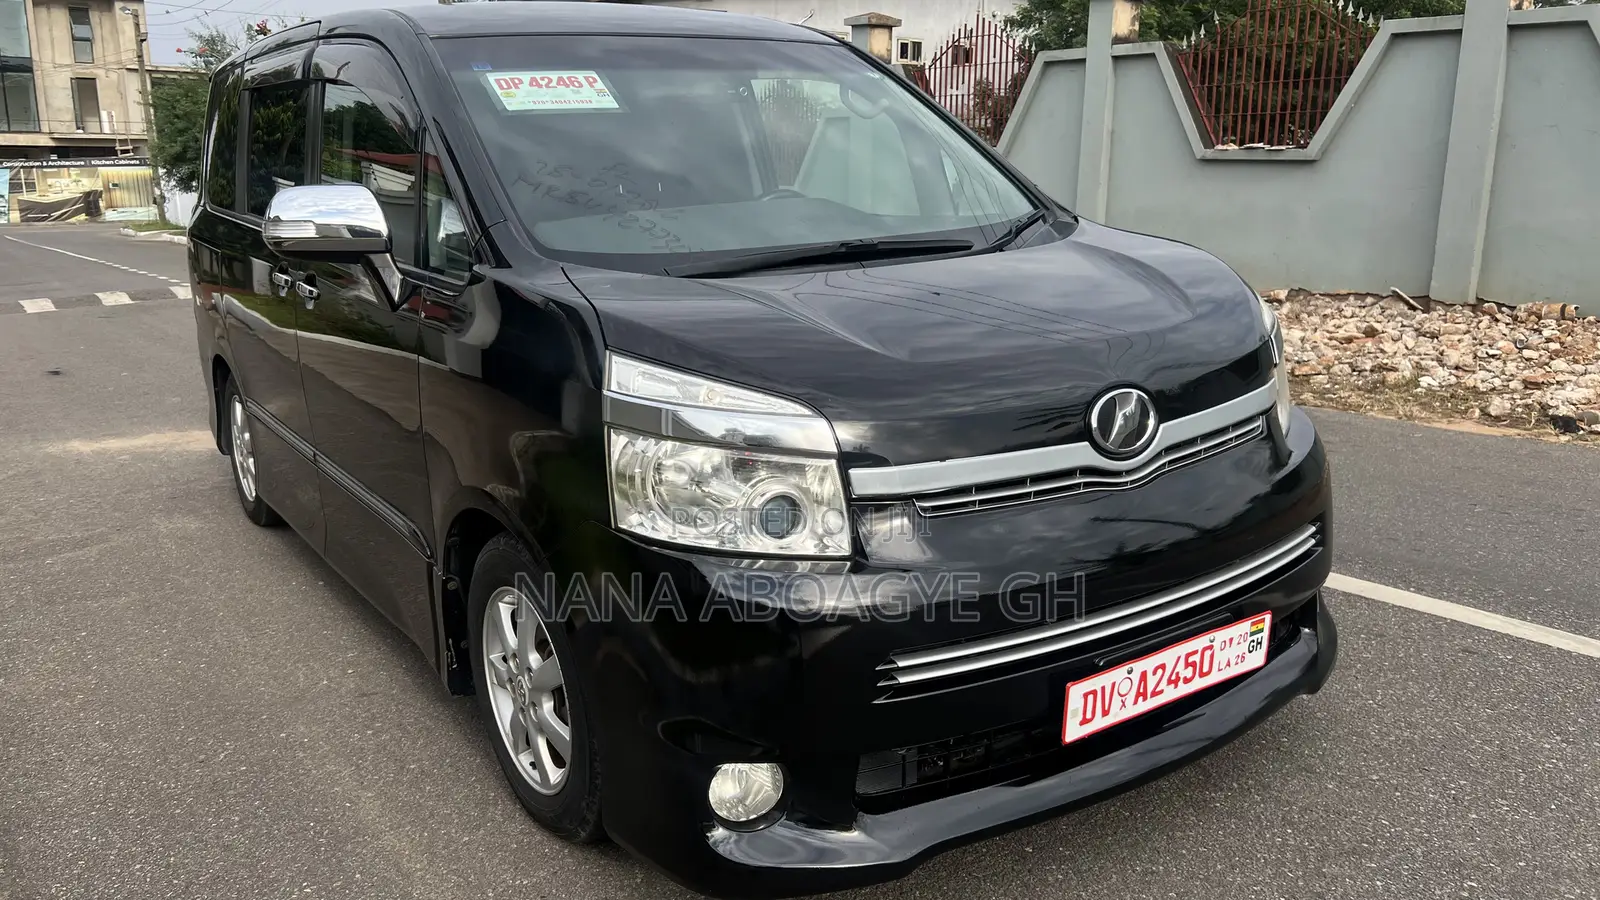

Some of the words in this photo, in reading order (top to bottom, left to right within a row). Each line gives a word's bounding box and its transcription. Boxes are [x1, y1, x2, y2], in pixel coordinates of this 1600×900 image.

[494, 77, 524, 91] DP
[528, 76, 584, 89] 4246
[582, 76, 598, 89] P
[1237, 631, 1249, 646] 20
[1248, 636, 1263, 654] GH
[1217, 659, 1231, 672] LA
[1079, 682, 1116, 726] DV
[1133, 645, 1215, 705] A2450
